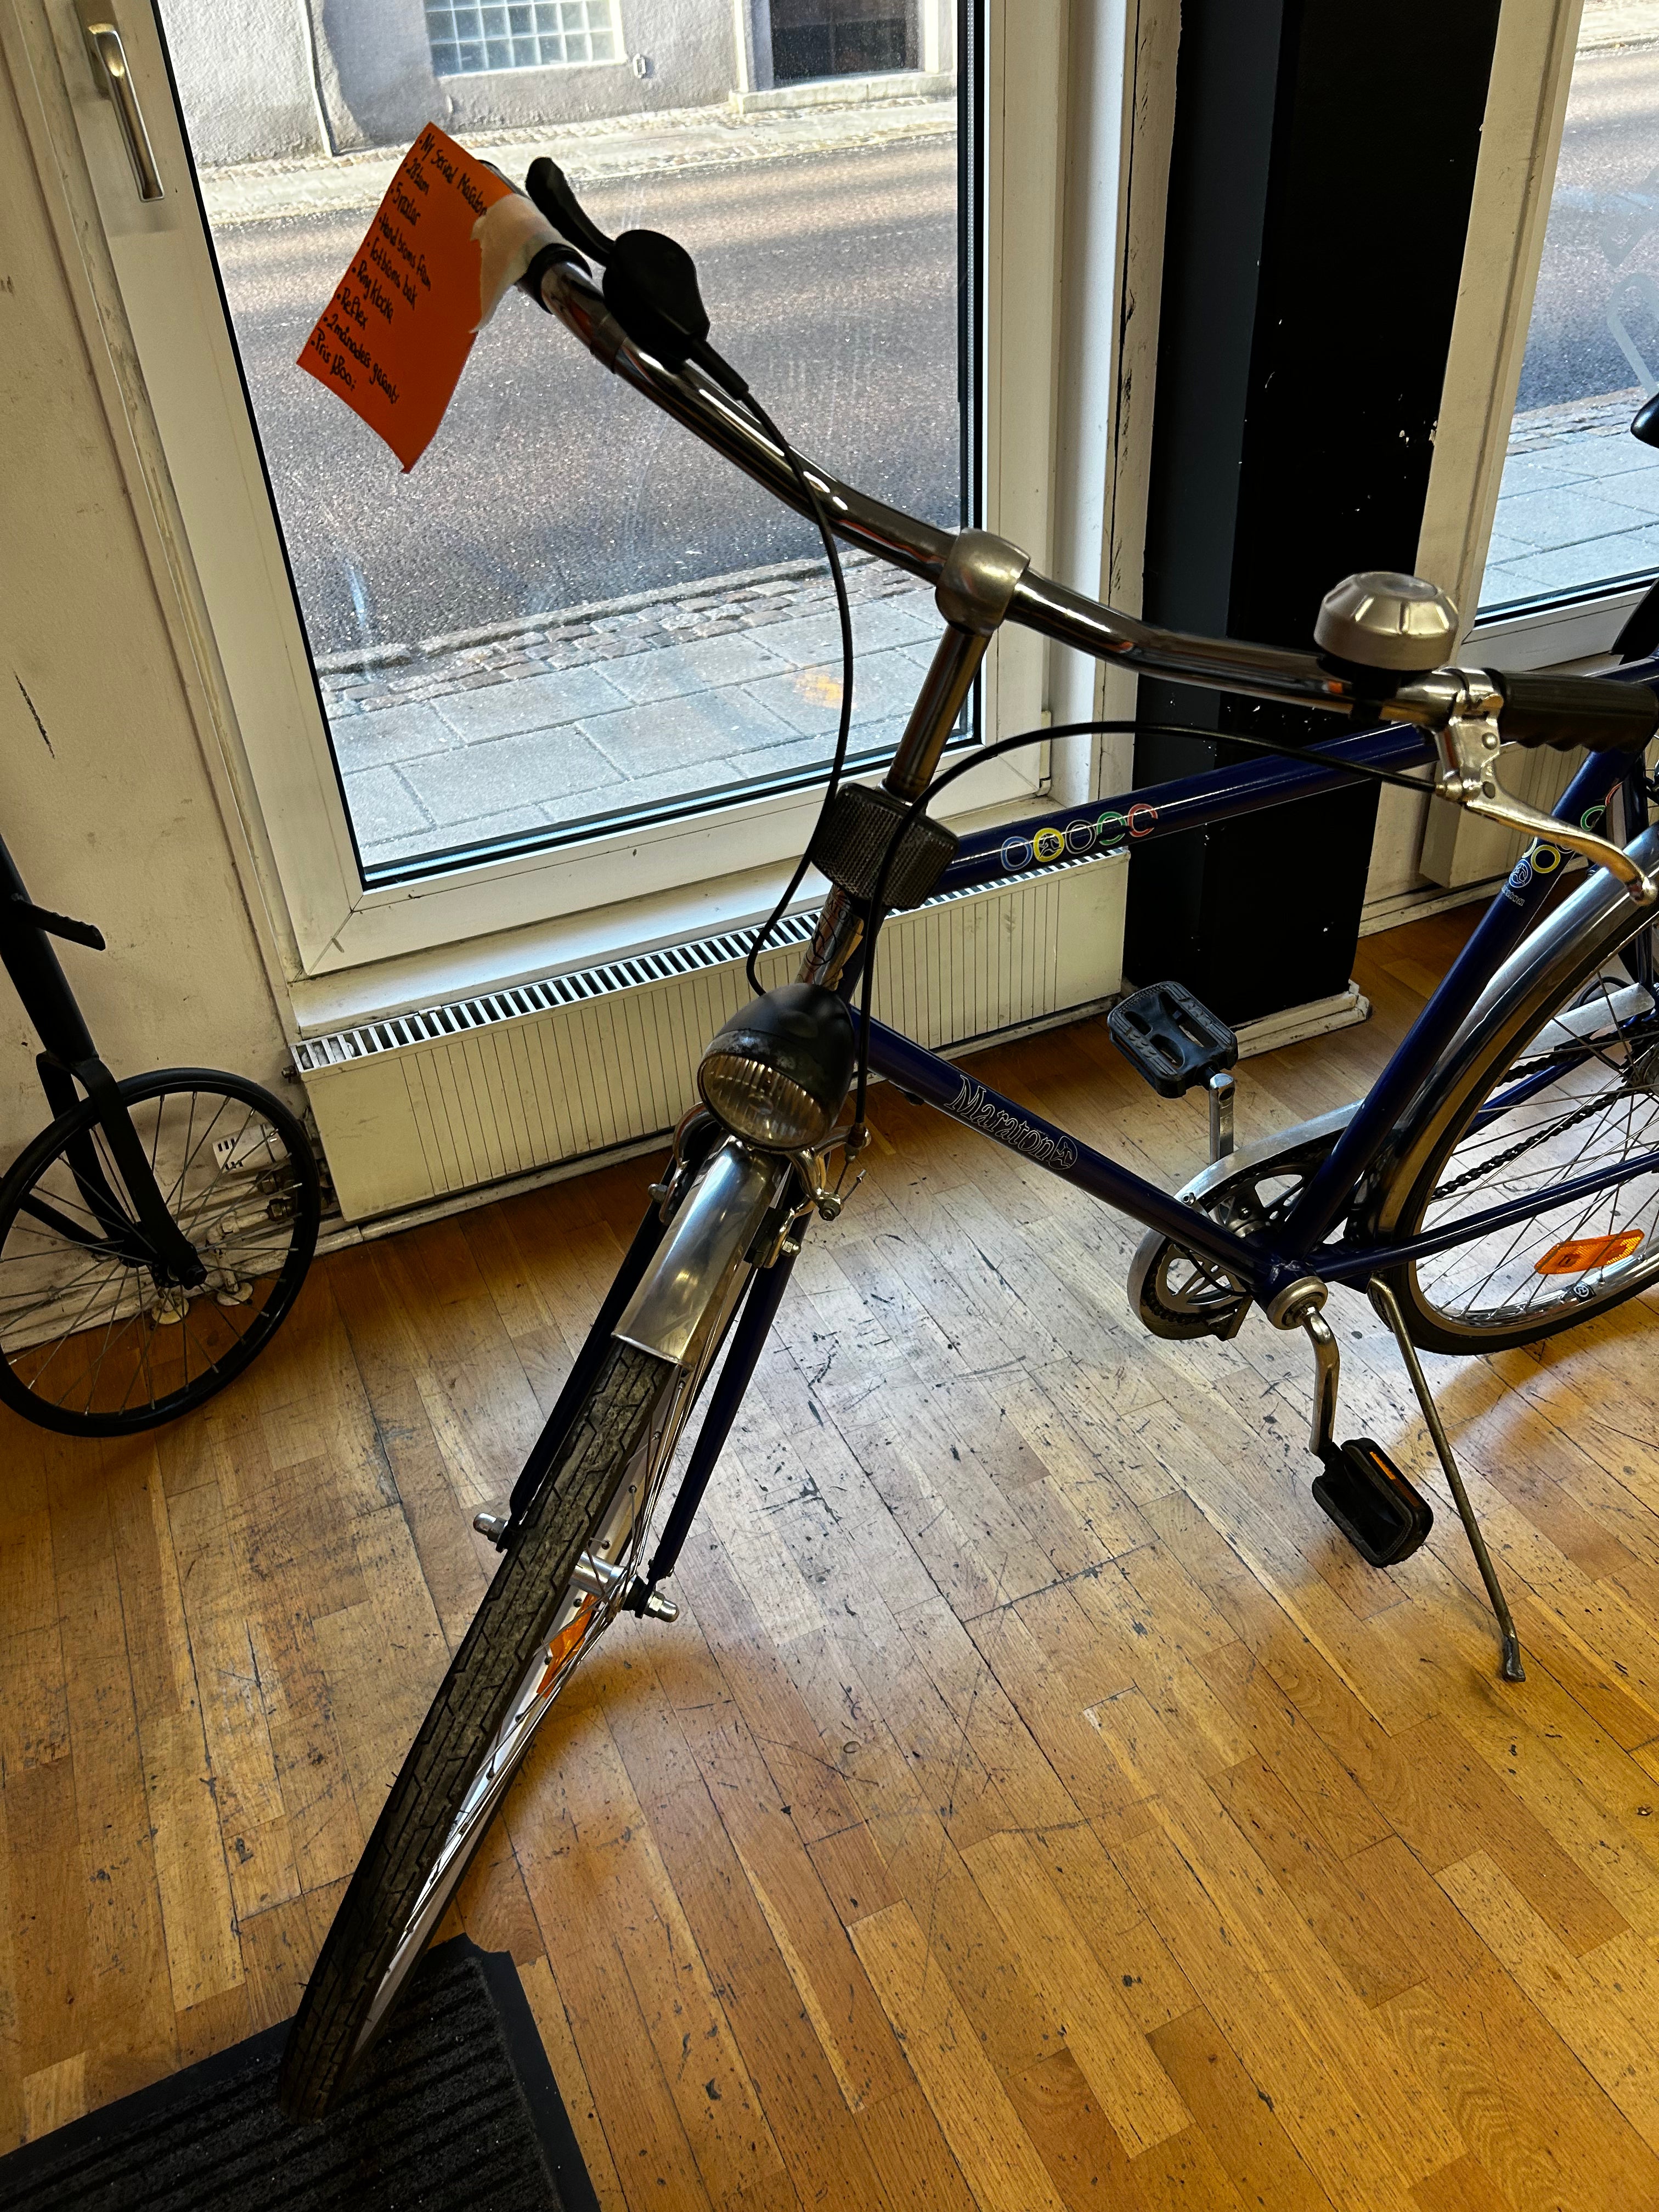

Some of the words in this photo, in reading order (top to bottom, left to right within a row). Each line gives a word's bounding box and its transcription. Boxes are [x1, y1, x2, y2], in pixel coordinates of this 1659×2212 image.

[421, 133, 435, 161] Ny
[341, 287, 368, 330] Reflex
[315, 328, 331, 364] Pris
[943, 1074, 1054, 1161] Maraton
